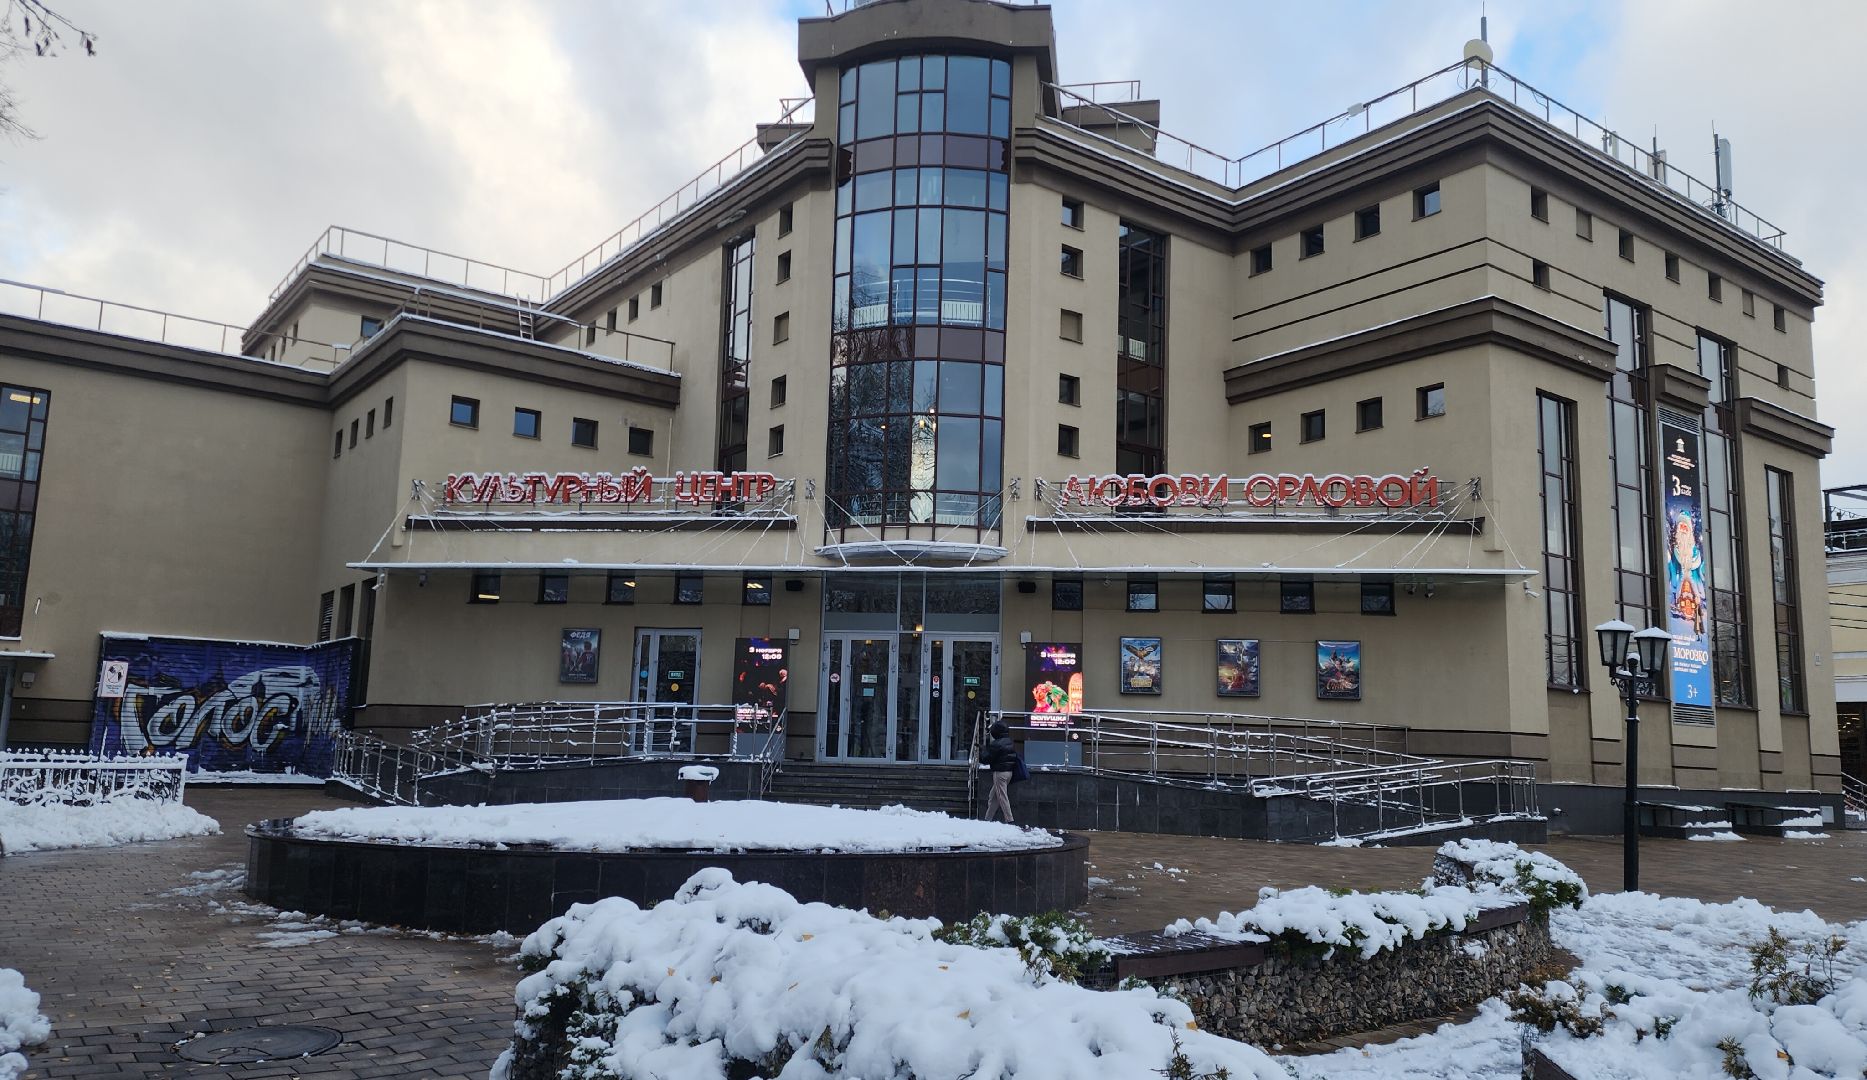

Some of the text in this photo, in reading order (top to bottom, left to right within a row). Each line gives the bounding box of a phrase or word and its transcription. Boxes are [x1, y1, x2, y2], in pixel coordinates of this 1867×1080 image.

[445, 465, 776, 506] КУЛЬТУРНЫЙ ЦЕНТР
[1061, 466, 1438, 507] ЛЮБОВИ ОРЛОВОЙ
[1687, 684, 1698, 698] 3+
